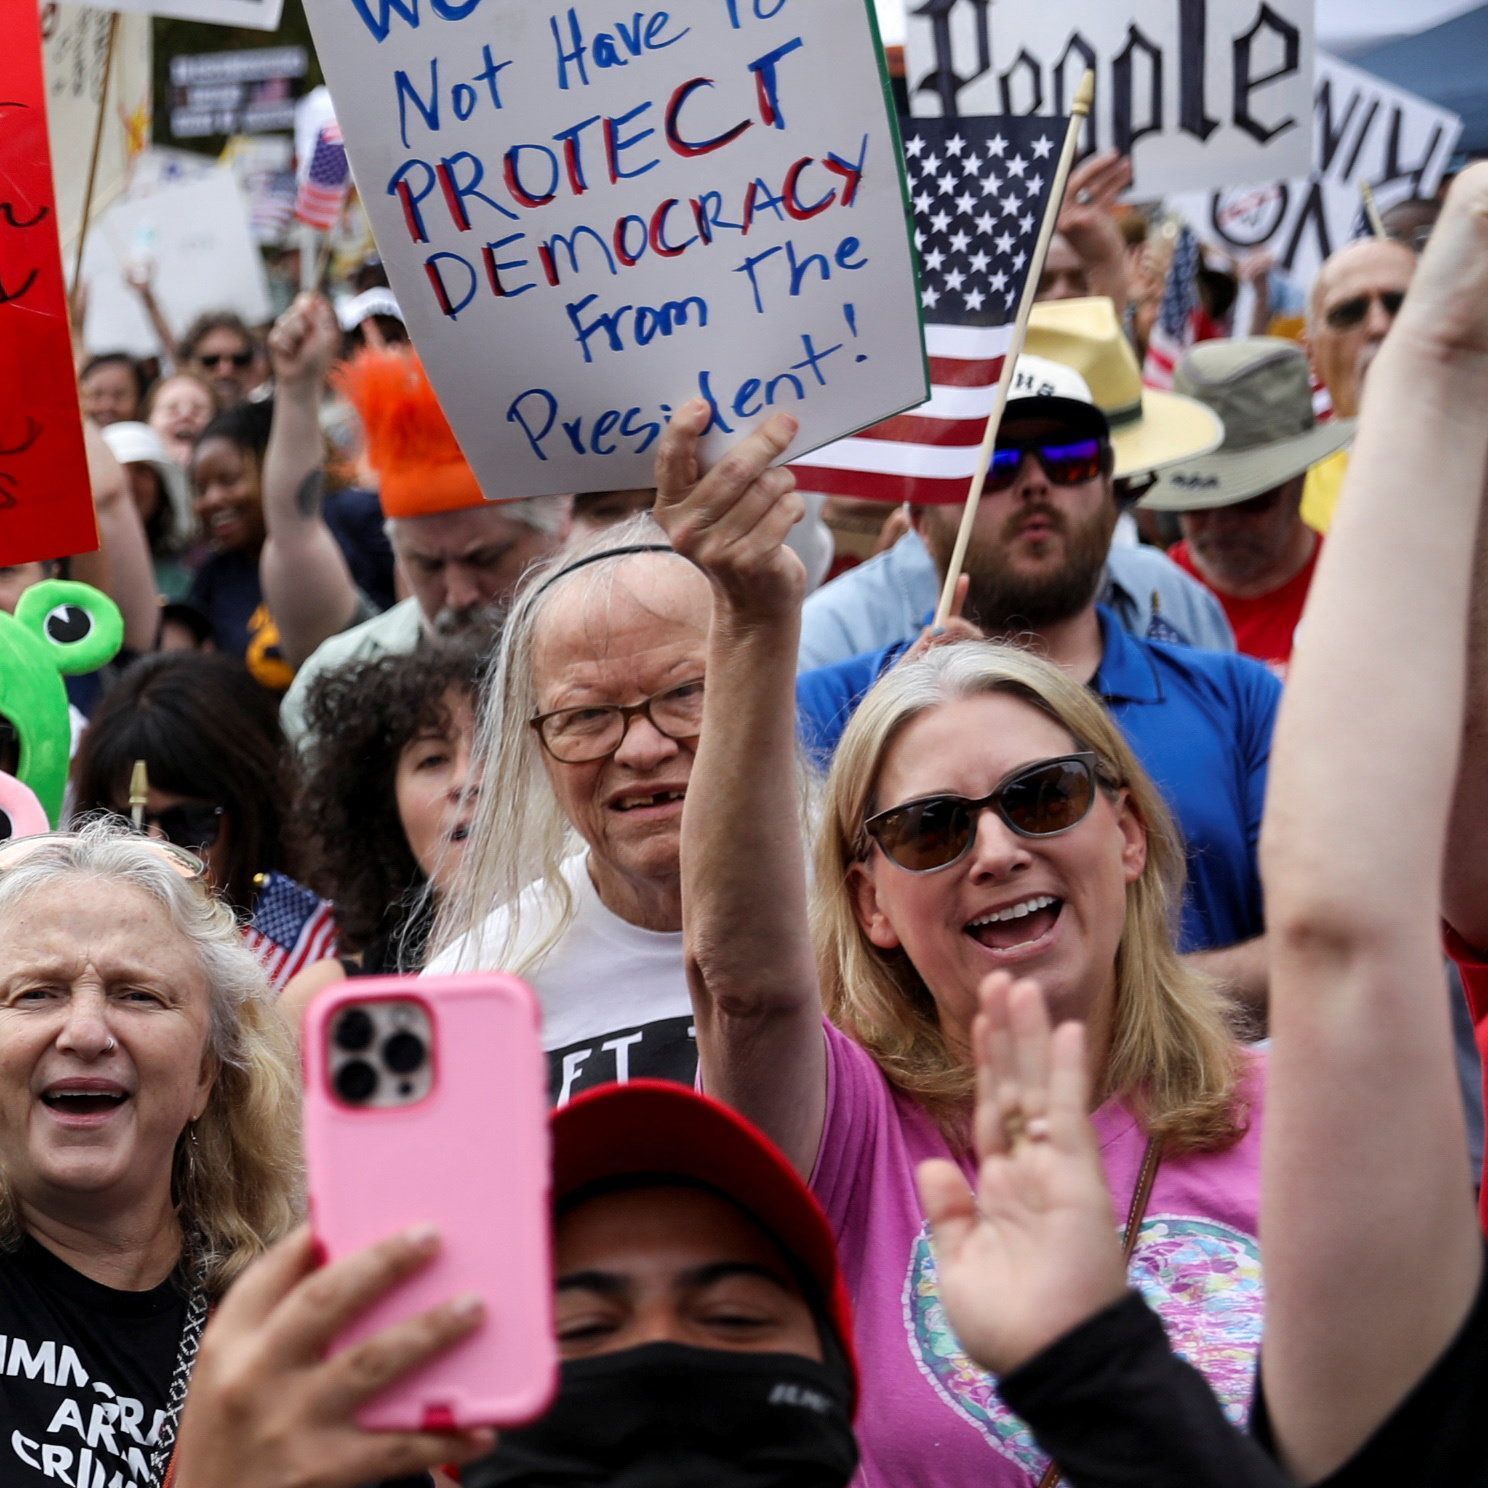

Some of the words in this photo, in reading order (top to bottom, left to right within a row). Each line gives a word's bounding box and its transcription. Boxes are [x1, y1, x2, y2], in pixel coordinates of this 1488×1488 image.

[387, 36, 805, 244] PROTECT
[394, 44, 514, 149] Not
[550, 7, 691, 90] Have
[424, 133, 870, 321] DEMOCRACY
[566, 293, 709, 363] From
[732, 235, 869, 314] The
